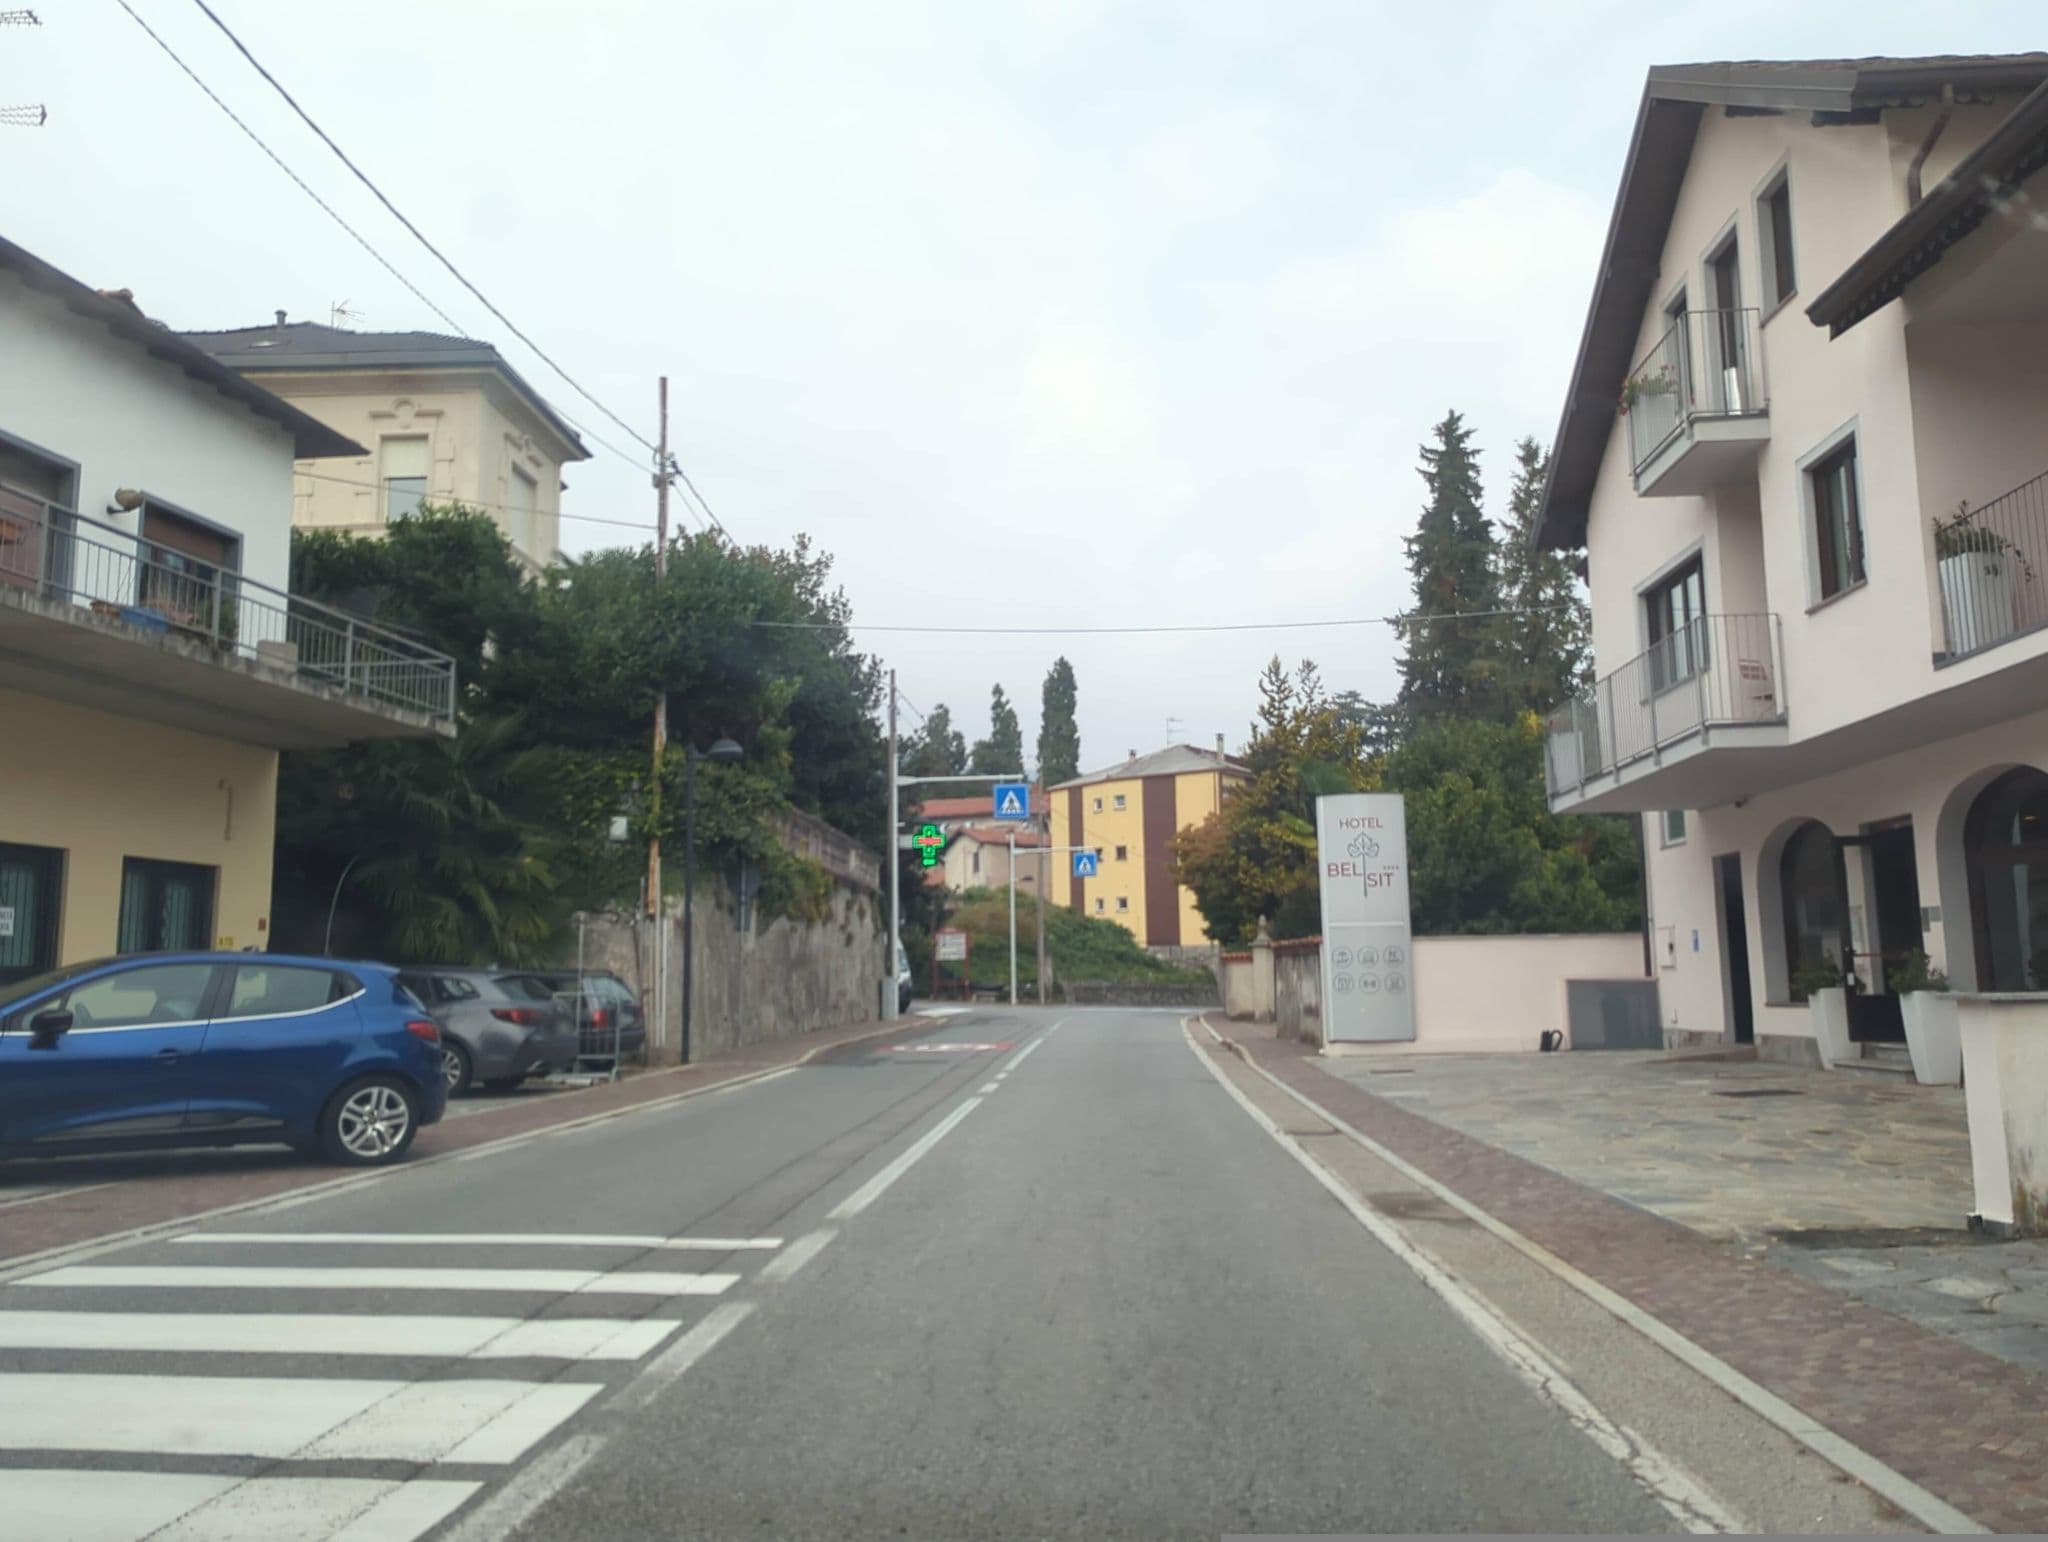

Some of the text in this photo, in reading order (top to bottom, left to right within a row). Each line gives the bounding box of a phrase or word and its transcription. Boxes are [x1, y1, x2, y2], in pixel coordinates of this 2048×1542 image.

[1339, 817, 1383, 830] HOTEL
[1327, 862, 1394, 888] BEL SIT
